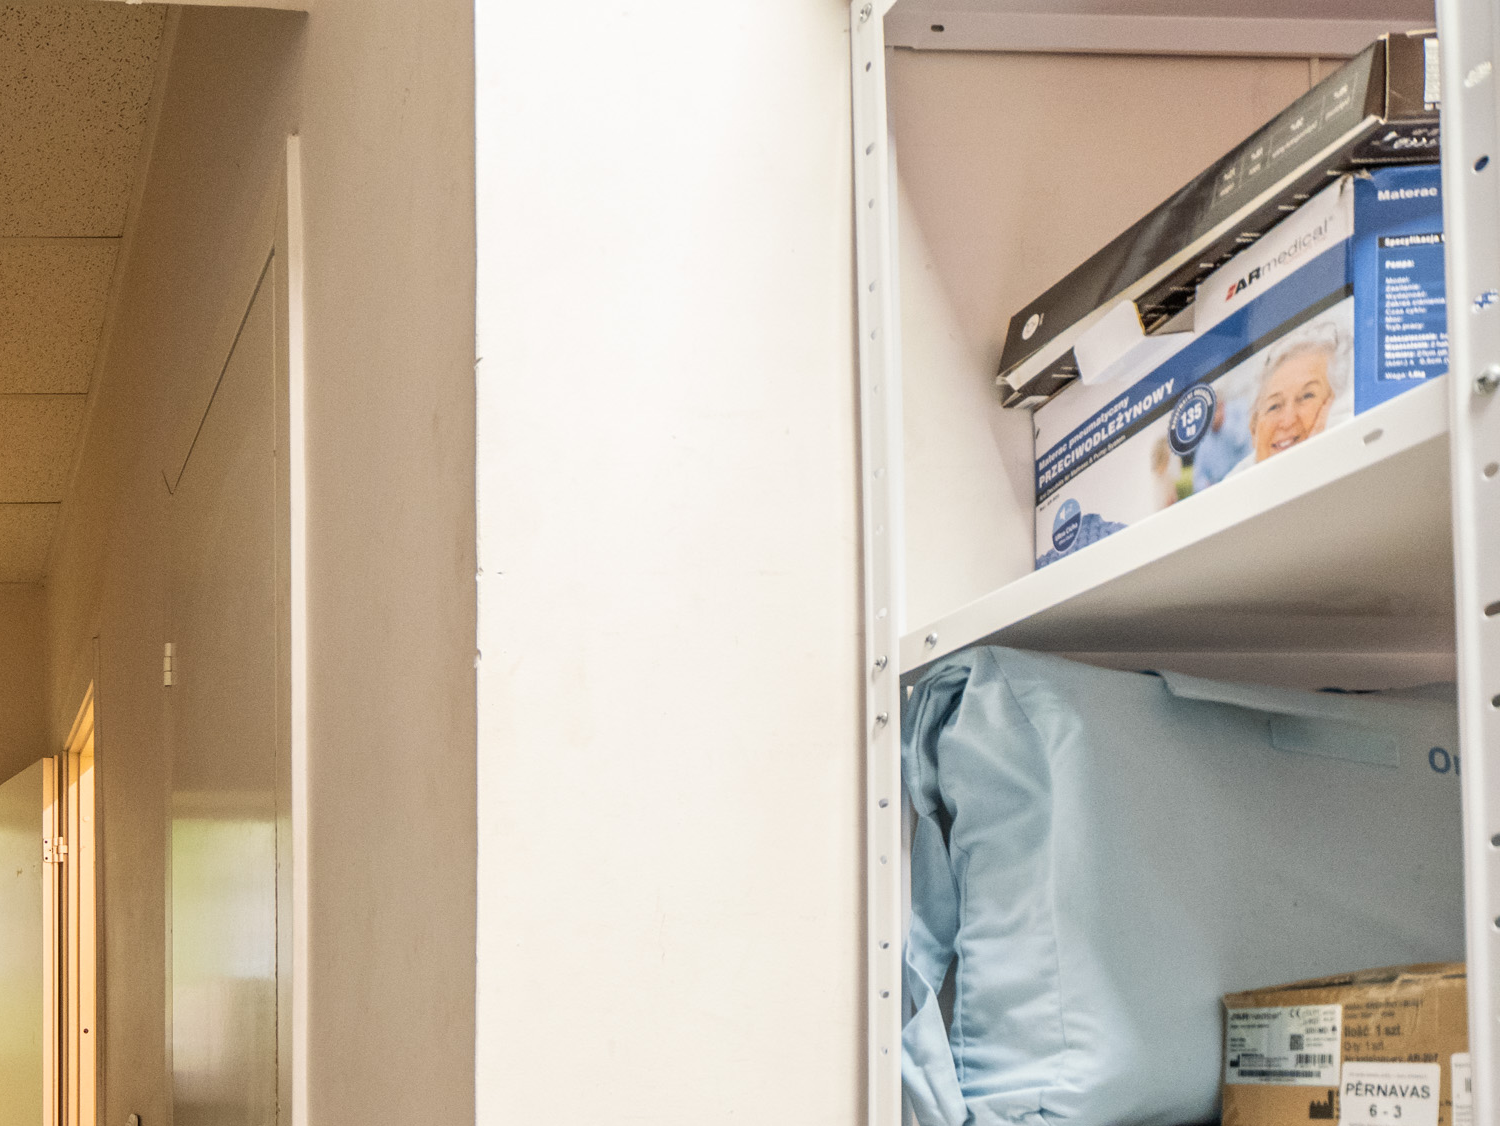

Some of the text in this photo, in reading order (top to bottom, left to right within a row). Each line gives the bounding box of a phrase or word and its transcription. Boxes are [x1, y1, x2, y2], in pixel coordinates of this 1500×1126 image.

[1378, 186, 1438, 201] Materac
[1181, 402, 1203, 428] 135
[1039, 378, 1175, 488] PRZECIWODLEŻYNOWY
[1369, 1104, 1377, 1117] 6
[1393, 1105, 1402, 1118] 3
